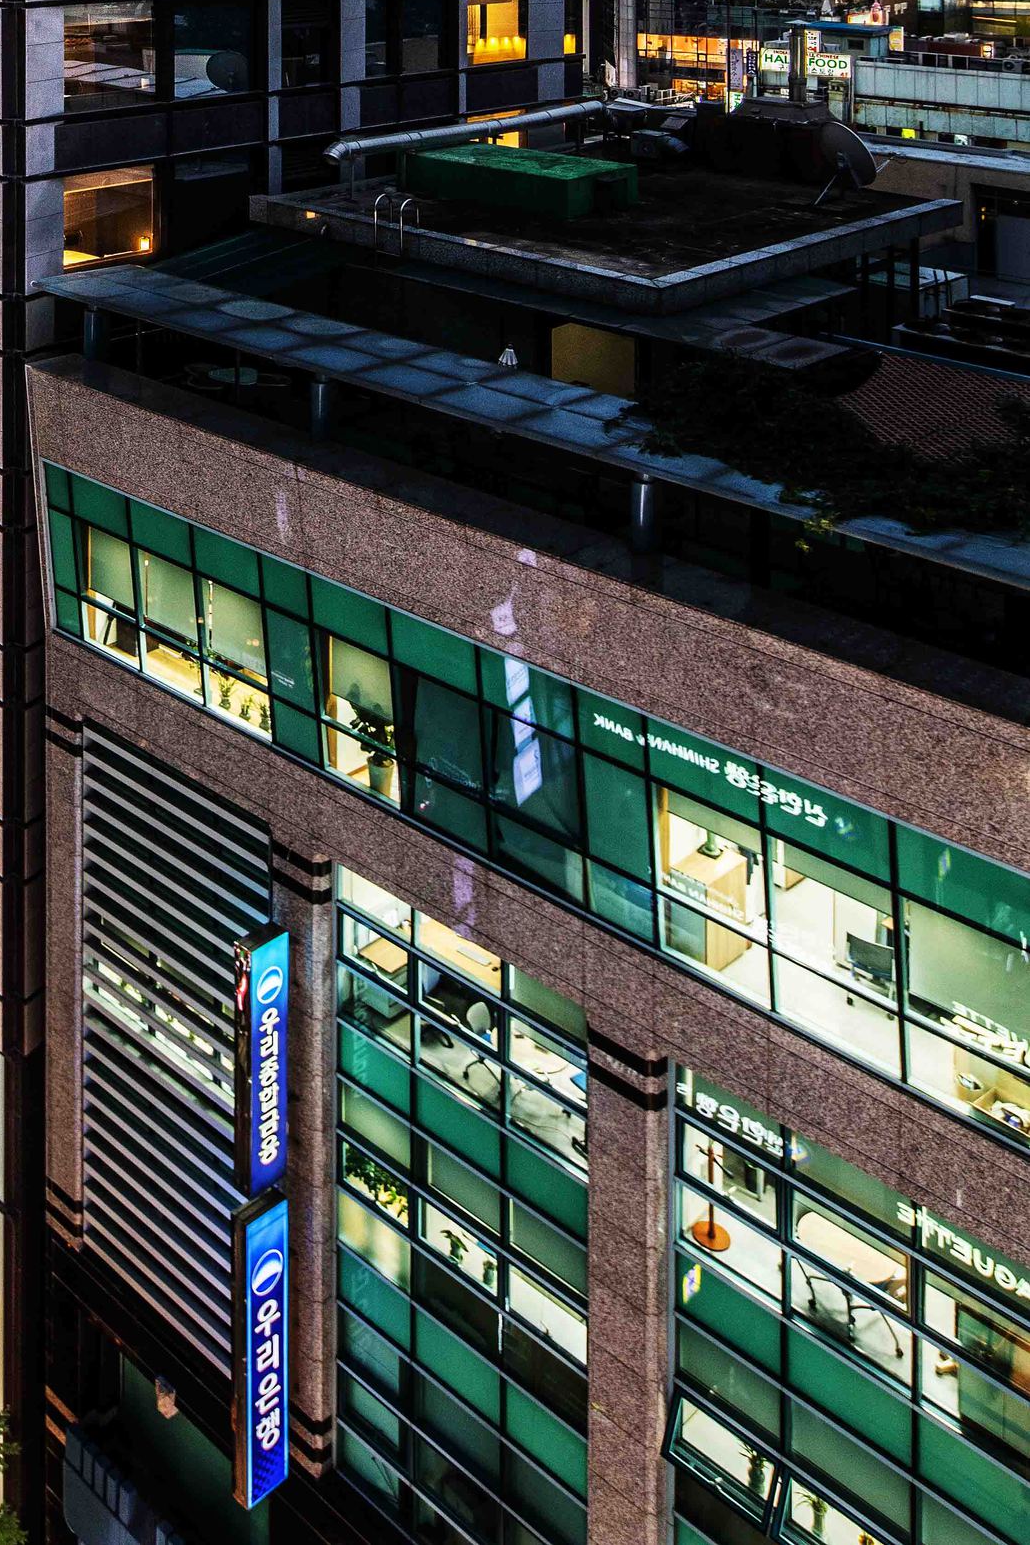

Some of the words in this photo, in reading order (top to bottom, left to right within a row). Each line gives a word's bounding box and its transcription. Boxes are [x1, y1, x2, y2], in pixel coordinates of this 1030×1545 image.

[808, 57, 848, 69] FOOD
[257, 1006, 281, 1167] 우리종합금융
[253, 1297, 282, 1452] 우리은행
